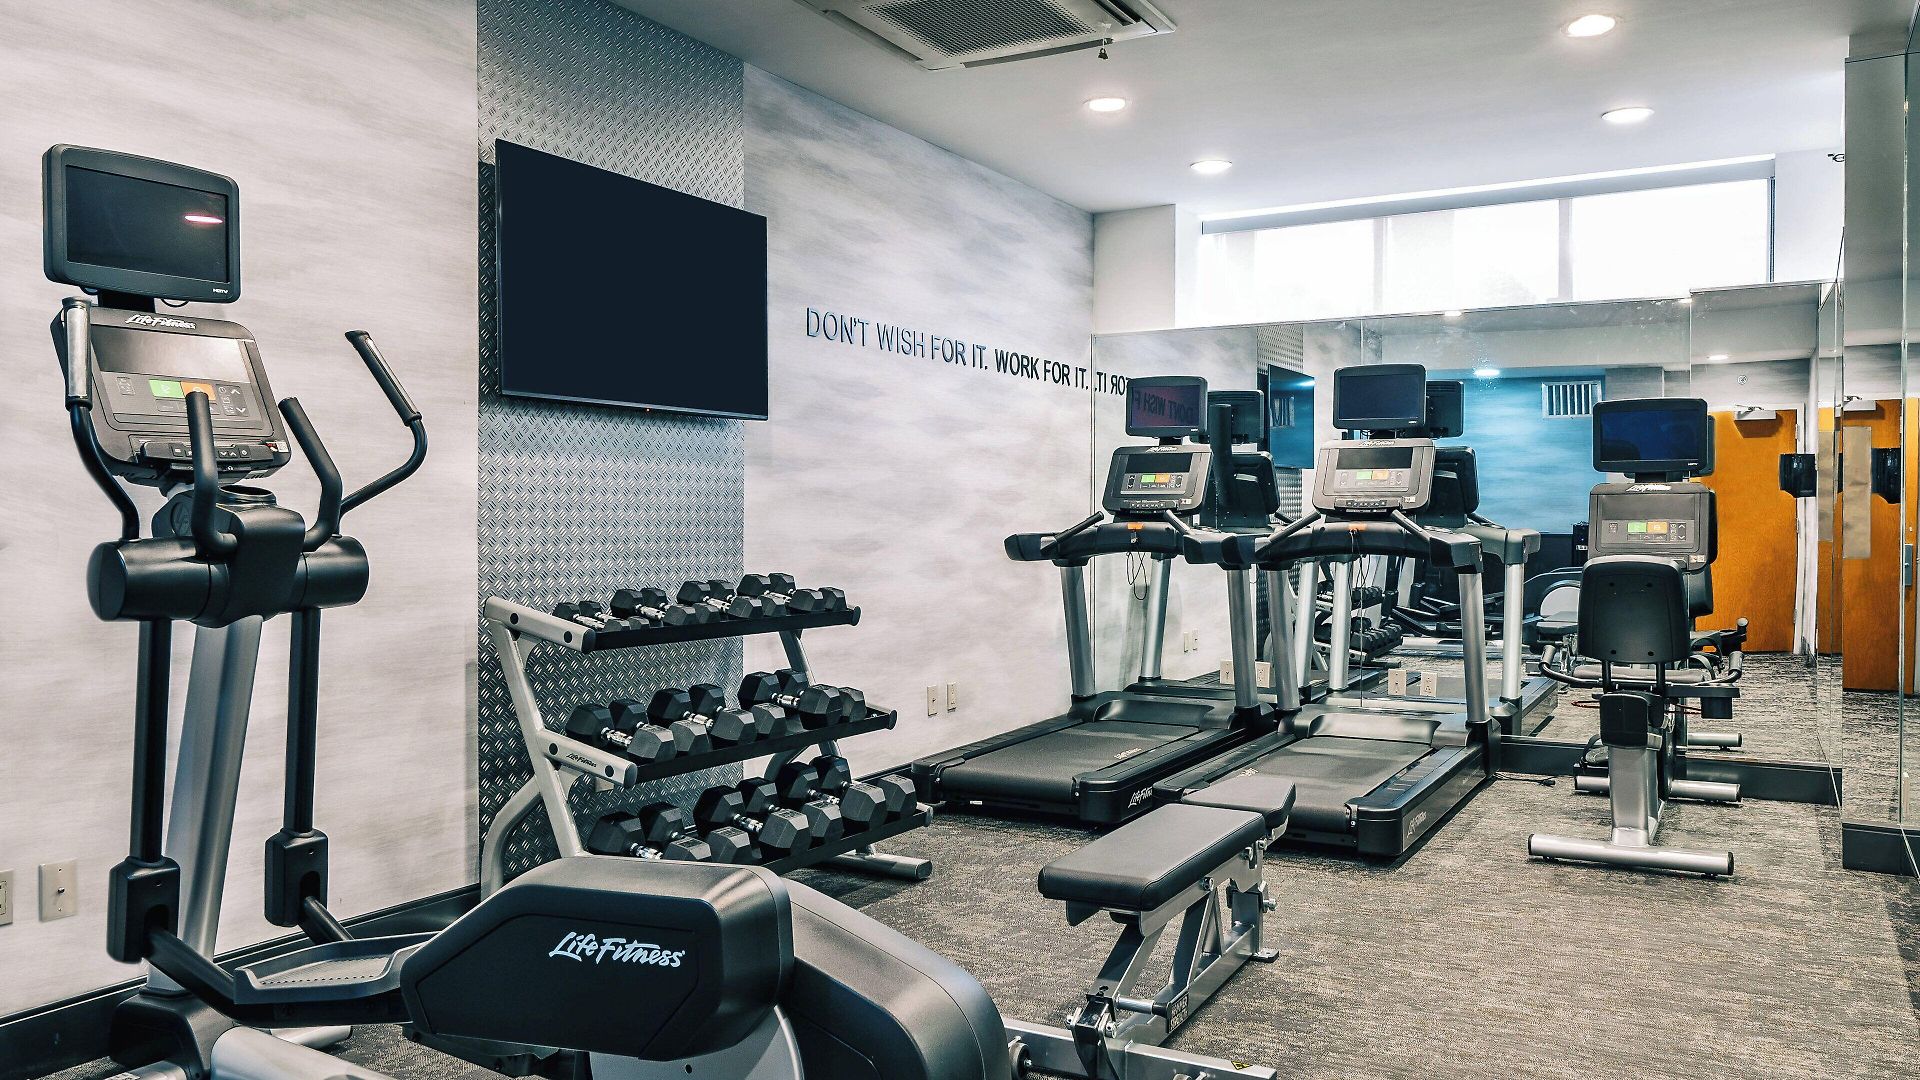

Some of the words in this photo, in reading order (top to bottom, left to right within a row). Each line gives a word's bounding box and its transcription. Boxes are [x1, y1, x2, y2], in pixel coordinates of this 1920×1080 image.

[805, 307, 869, 347] DON'T
[876, 322, 925, 359] WISH
[931, 335, 967, 366] FOR
[972, 344, 988, 371] IT.
[994, 348, 1040, 381] WORK
[1043, 359, 1071, 387] FOR
[1075, 366, 1089, 391] IT.
